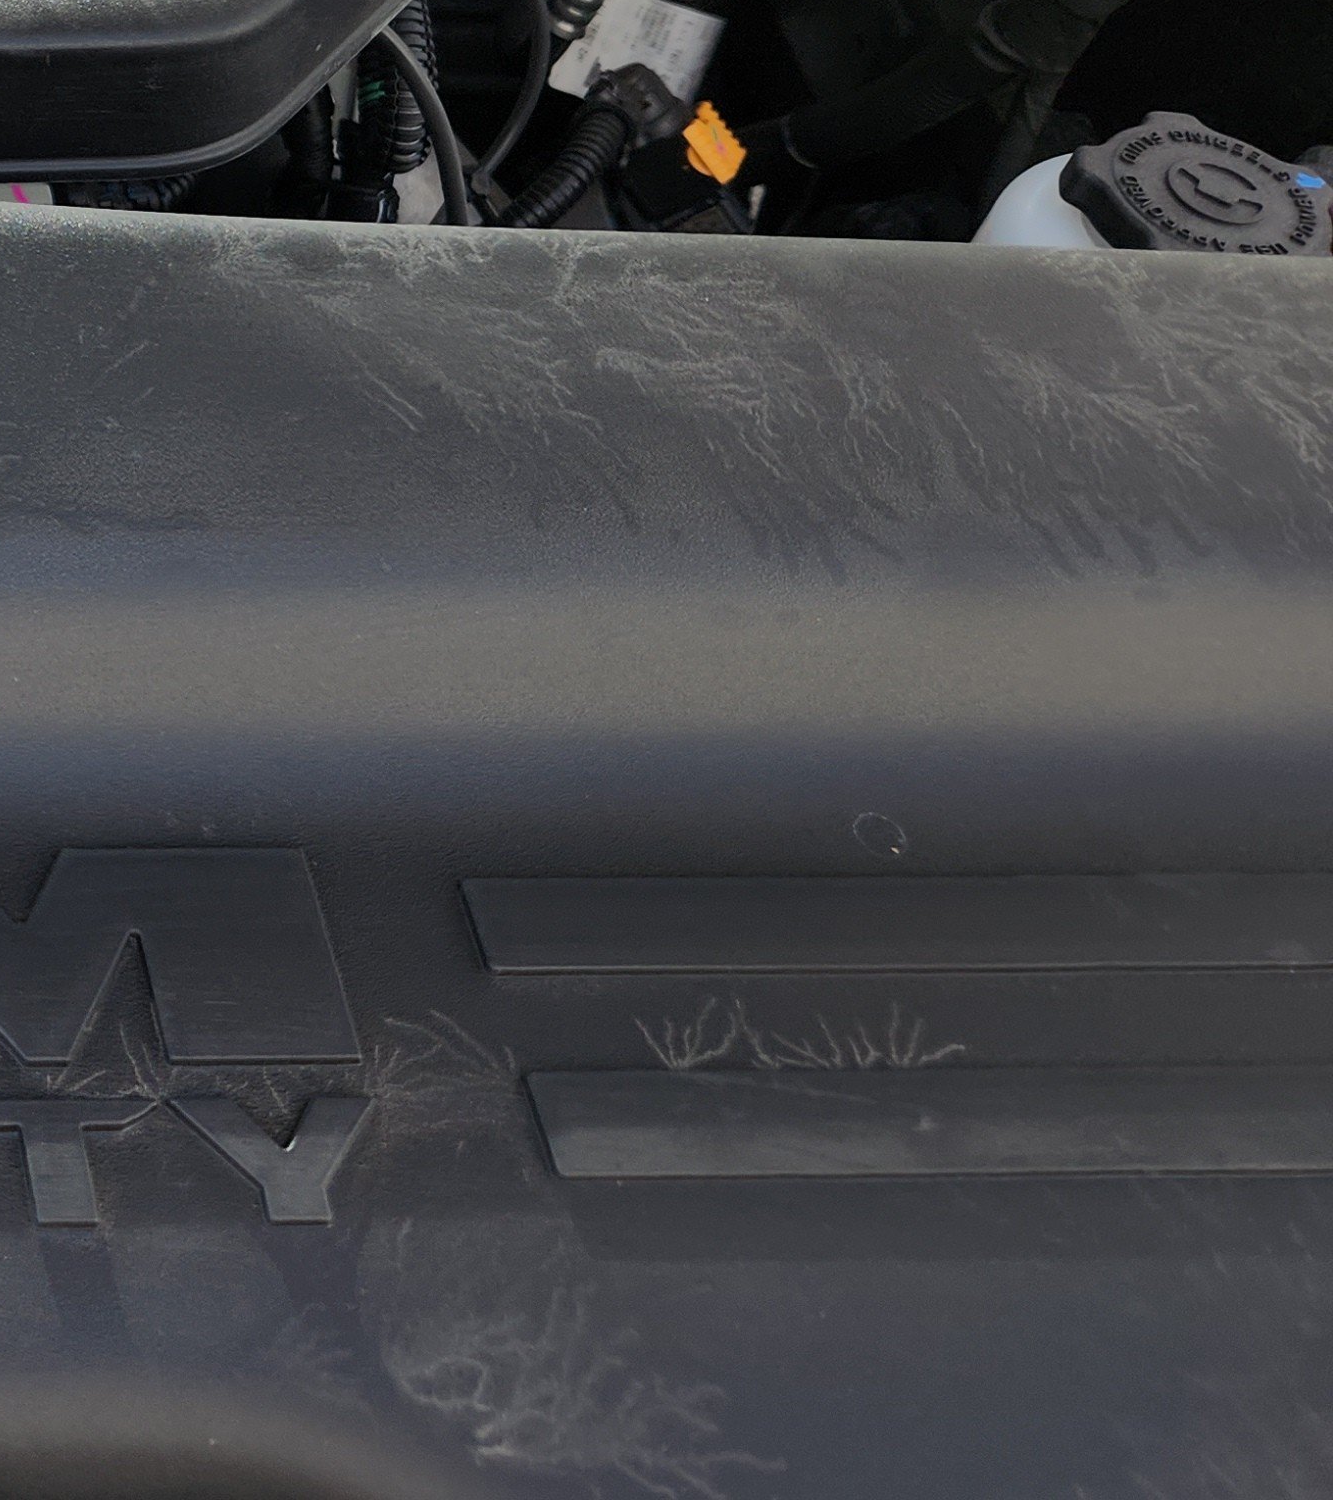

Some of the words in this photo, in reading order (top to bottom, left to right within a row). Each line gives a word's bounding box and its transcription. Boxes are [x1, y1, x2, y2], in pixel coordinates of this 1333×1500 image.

[1119, 131, 1165, 165] FLUID
[1167, 130, 1292, 183] STEERING
[1120, 175, 1228, 252] APPROVED
